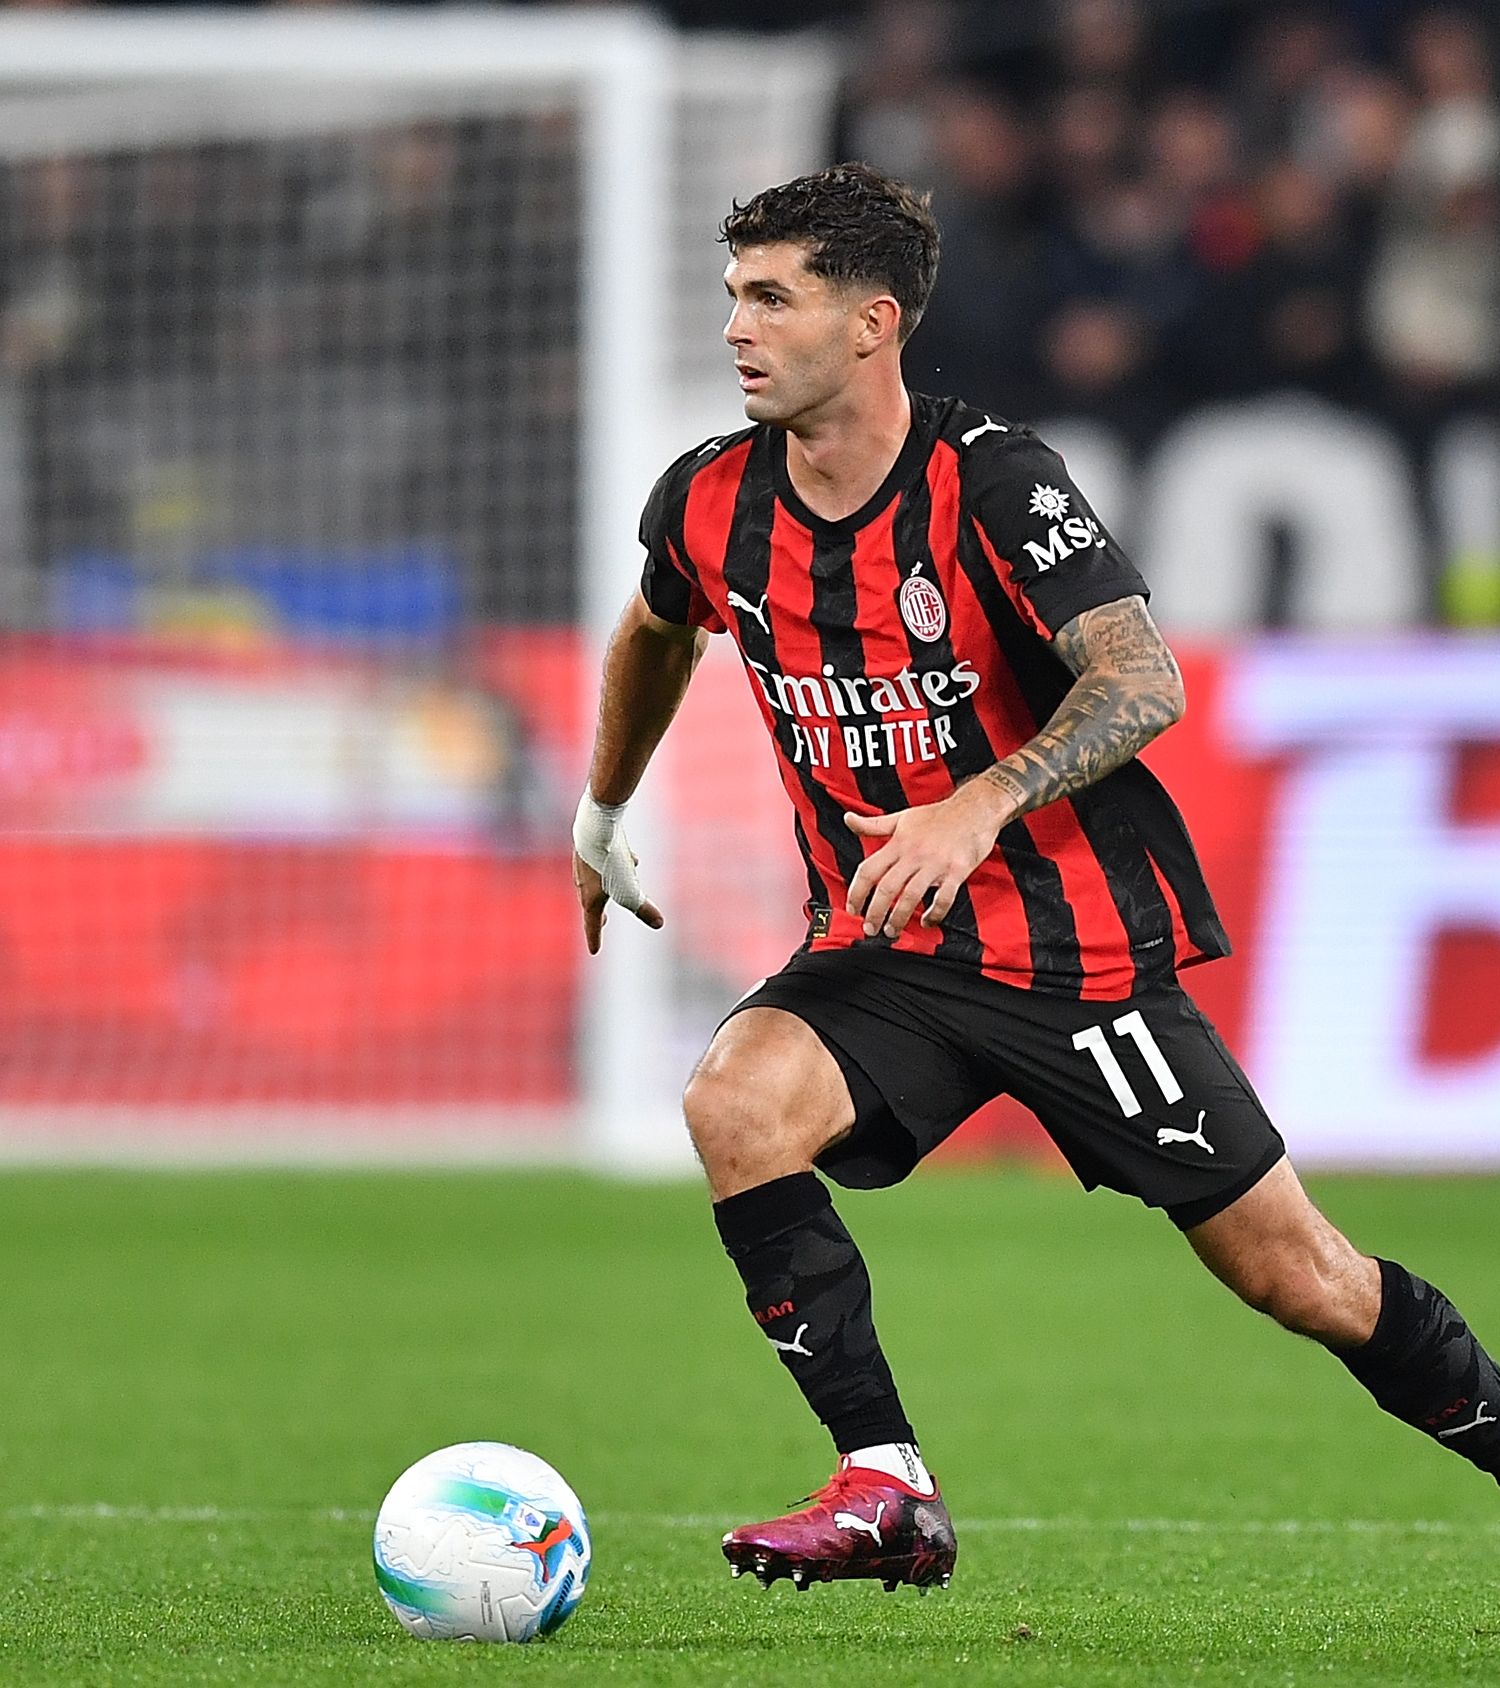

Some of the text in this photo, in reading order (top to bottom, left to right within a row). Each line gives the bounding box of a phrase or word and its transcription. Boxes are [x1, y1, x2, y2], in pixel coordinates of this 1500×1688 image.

[745, 655, 981, 717] Emirates
[791, 714, 958, 768] FLY BETTER
[1071, 1009, 1185, 1119] 11
